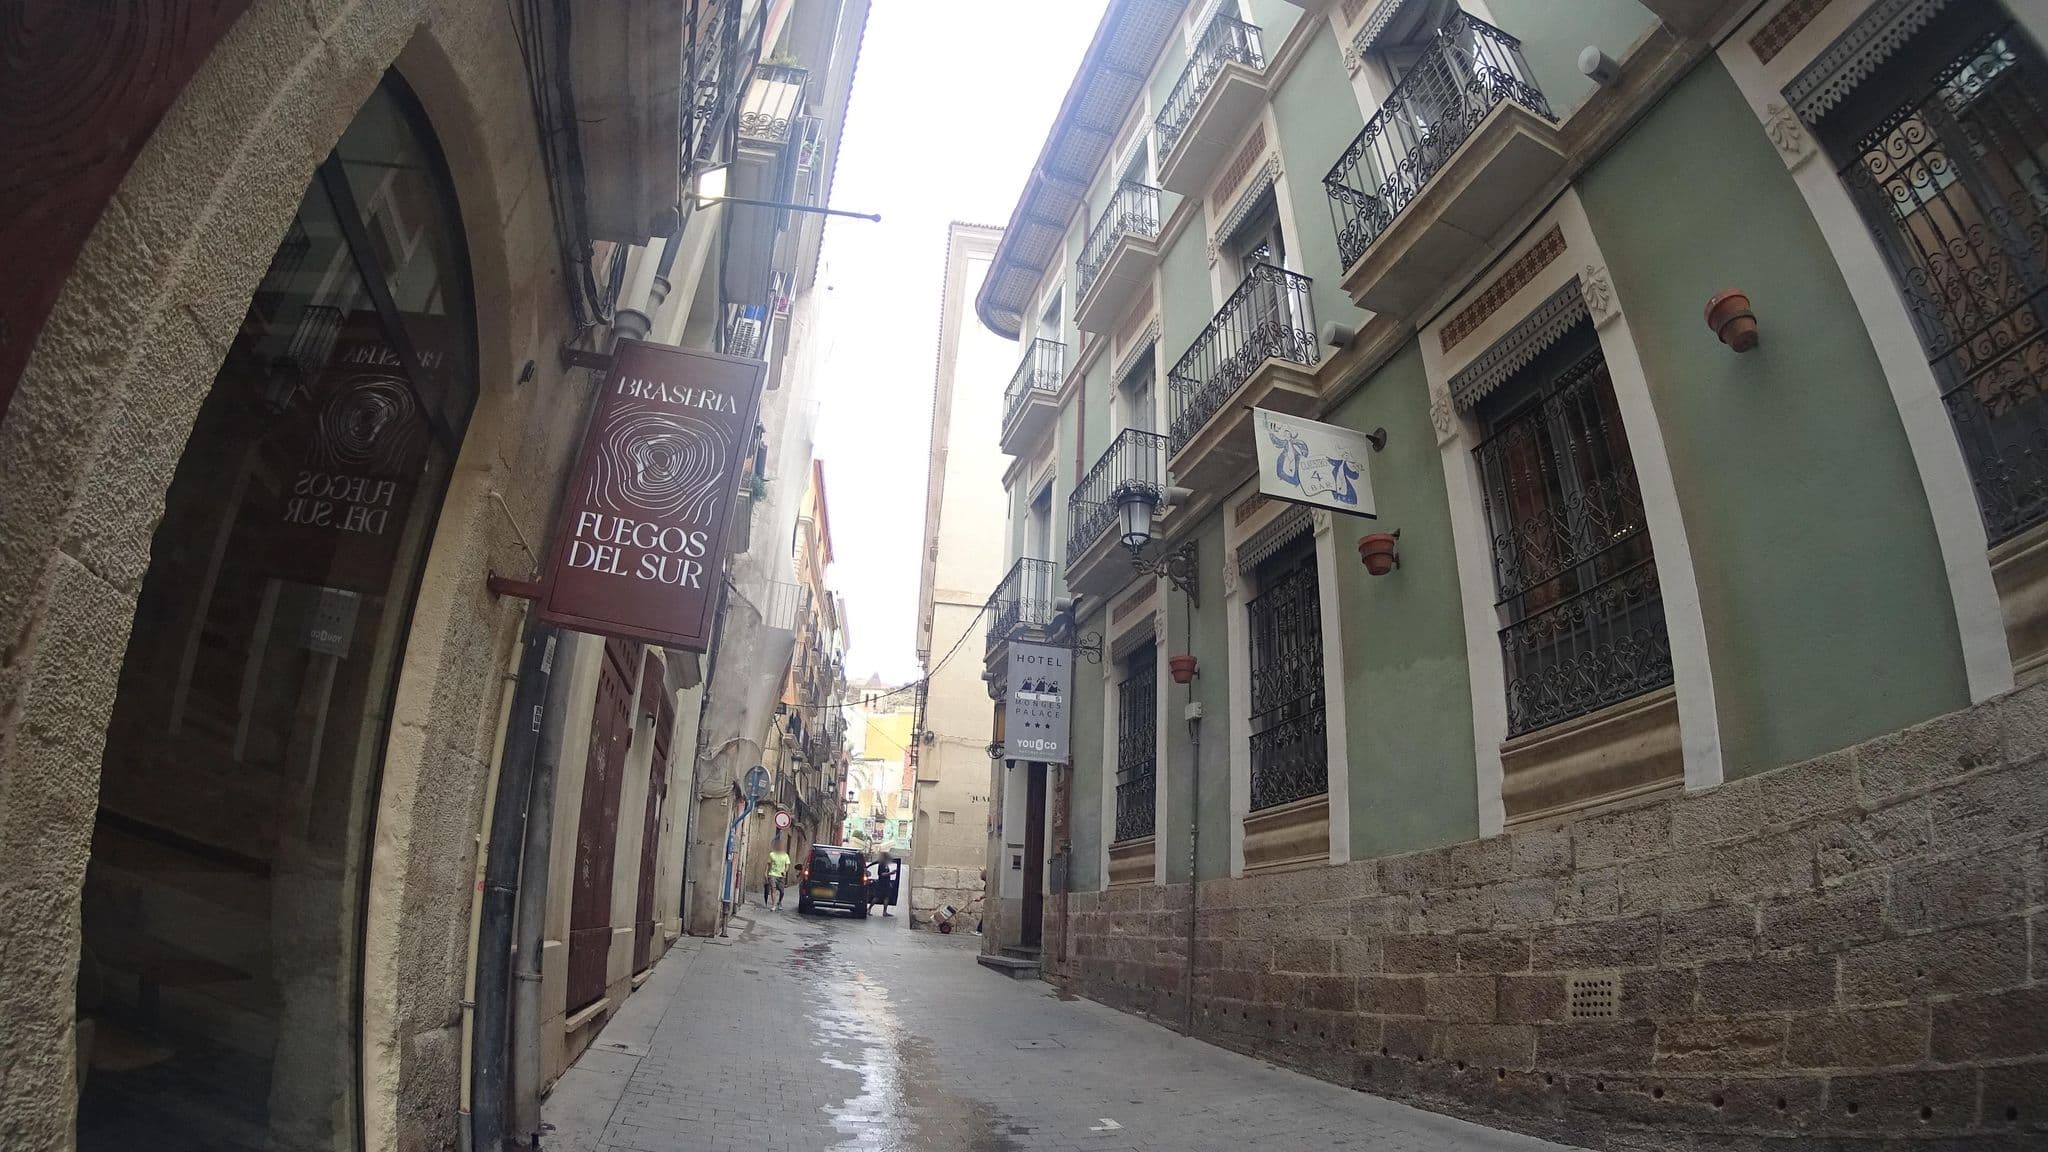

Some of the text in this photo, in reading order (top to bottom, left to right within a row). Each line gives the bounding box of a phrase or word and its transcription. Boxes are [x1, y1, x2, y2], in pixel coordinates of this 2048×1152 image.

[617, 375, 737, 415] BRASERIA
[1311, 470, 1323, 482] 4
[575, 511, 709, 558] FUEGOS
[568, 541, 704, 589] DEL SUR
[1016, 654, 1063, 667] HOTEL
[1016, 692, 1061, 702] LES
[1015, 699, 1061, 710] MONGES
[1015, 708, 1060, 719] PALACE
